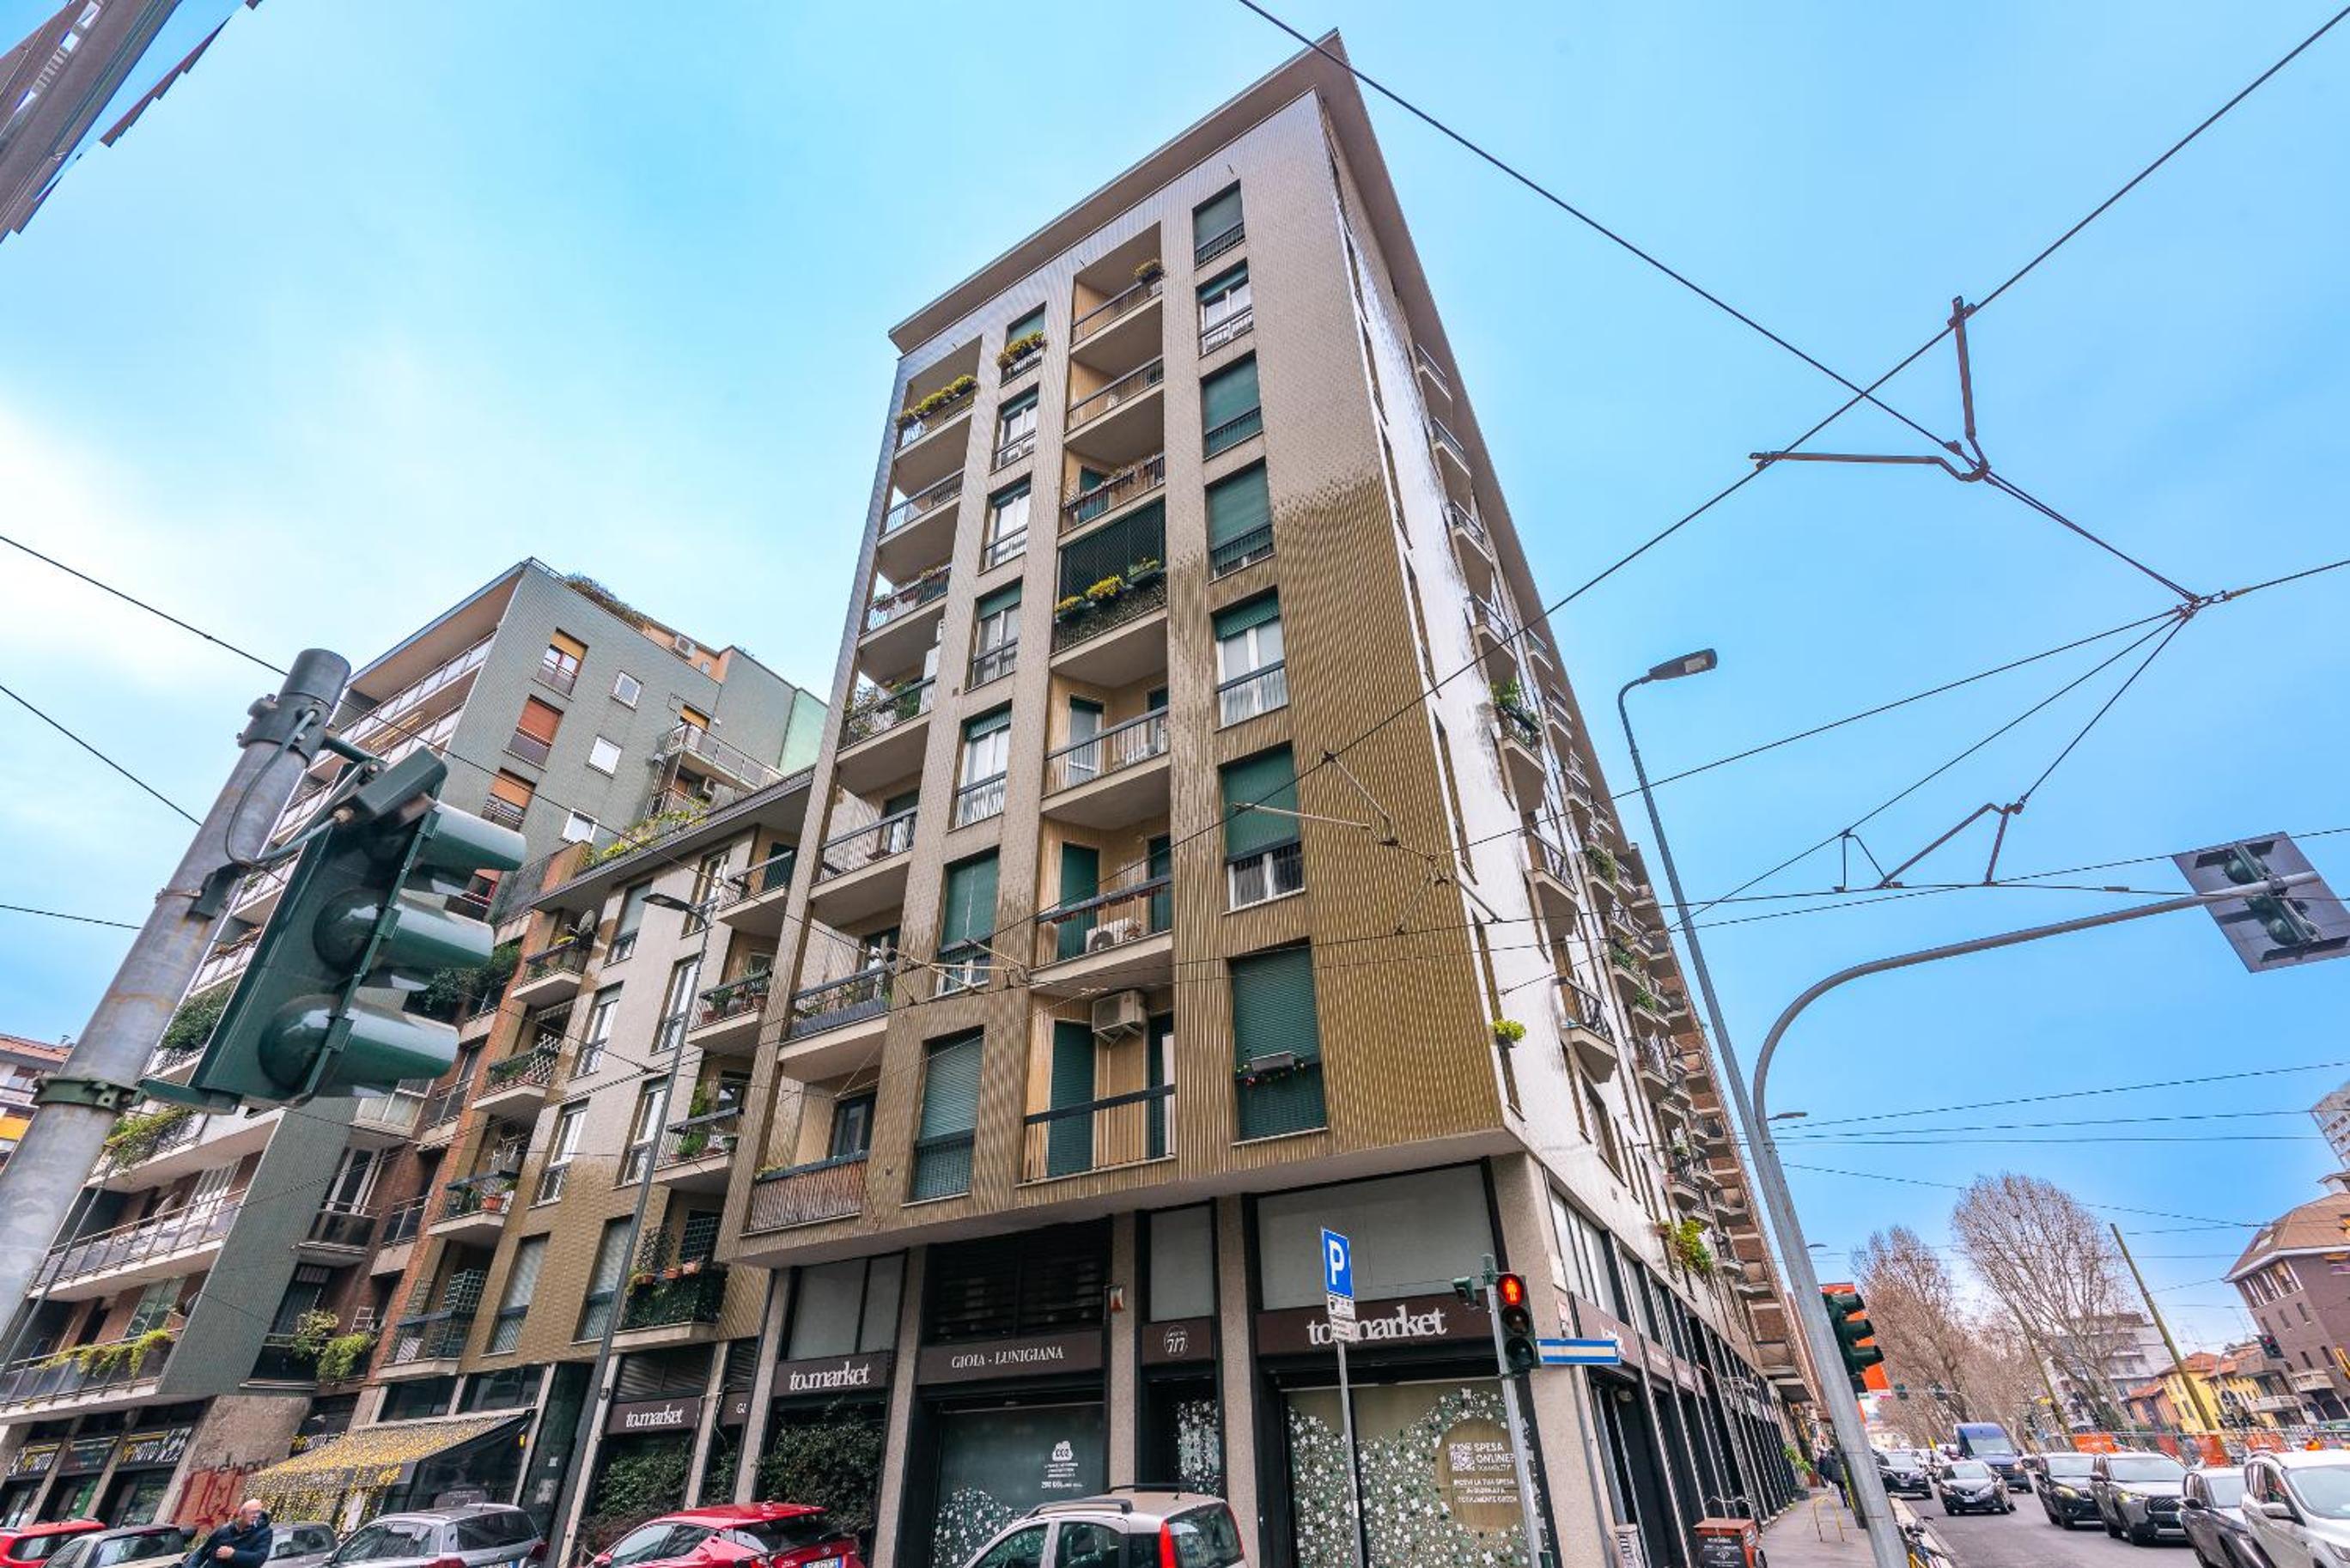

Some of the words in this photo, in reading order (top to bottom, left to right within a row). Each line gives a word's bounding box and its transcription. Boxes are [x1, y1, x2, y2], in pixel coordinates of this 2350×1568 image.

[1328, 1239, 1345, 1285] P
[952, 1354, 985, 1369] GIOIA
[995, 1346, 1065, 1364] LUNIGIANA
[1474, 1442, 1505, 1452] SPESA
[1476, 1453, 1515, 1464] ONLINE?
